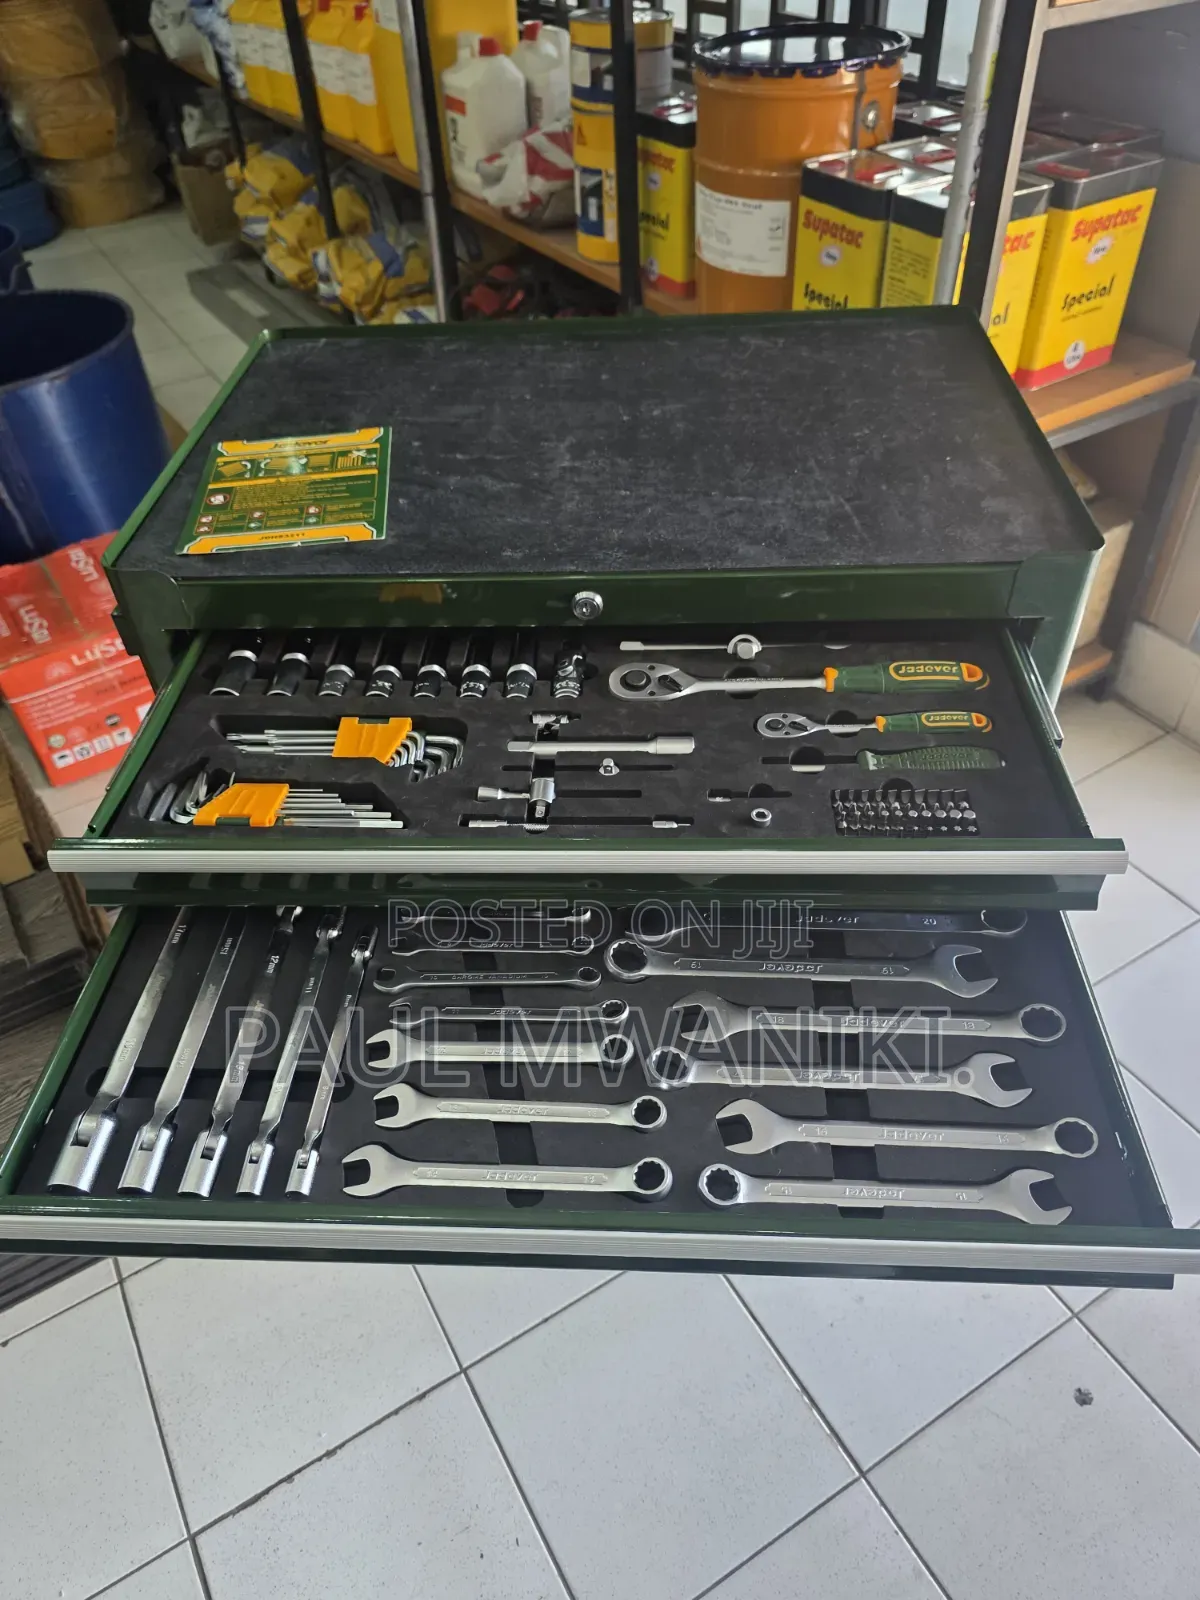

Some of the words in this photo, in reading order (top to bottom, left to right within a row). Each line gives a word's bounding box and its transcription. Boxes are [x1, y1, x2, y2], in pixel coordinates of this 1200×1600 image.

[802, 208, 864, 249] Supatac
[1071, 204, 1144, 244] Supatac
[1061, 274, 1116, 312] Special
[898, 663, 960, 674] Jadever
[926, 714, 969, 722] Jadever
